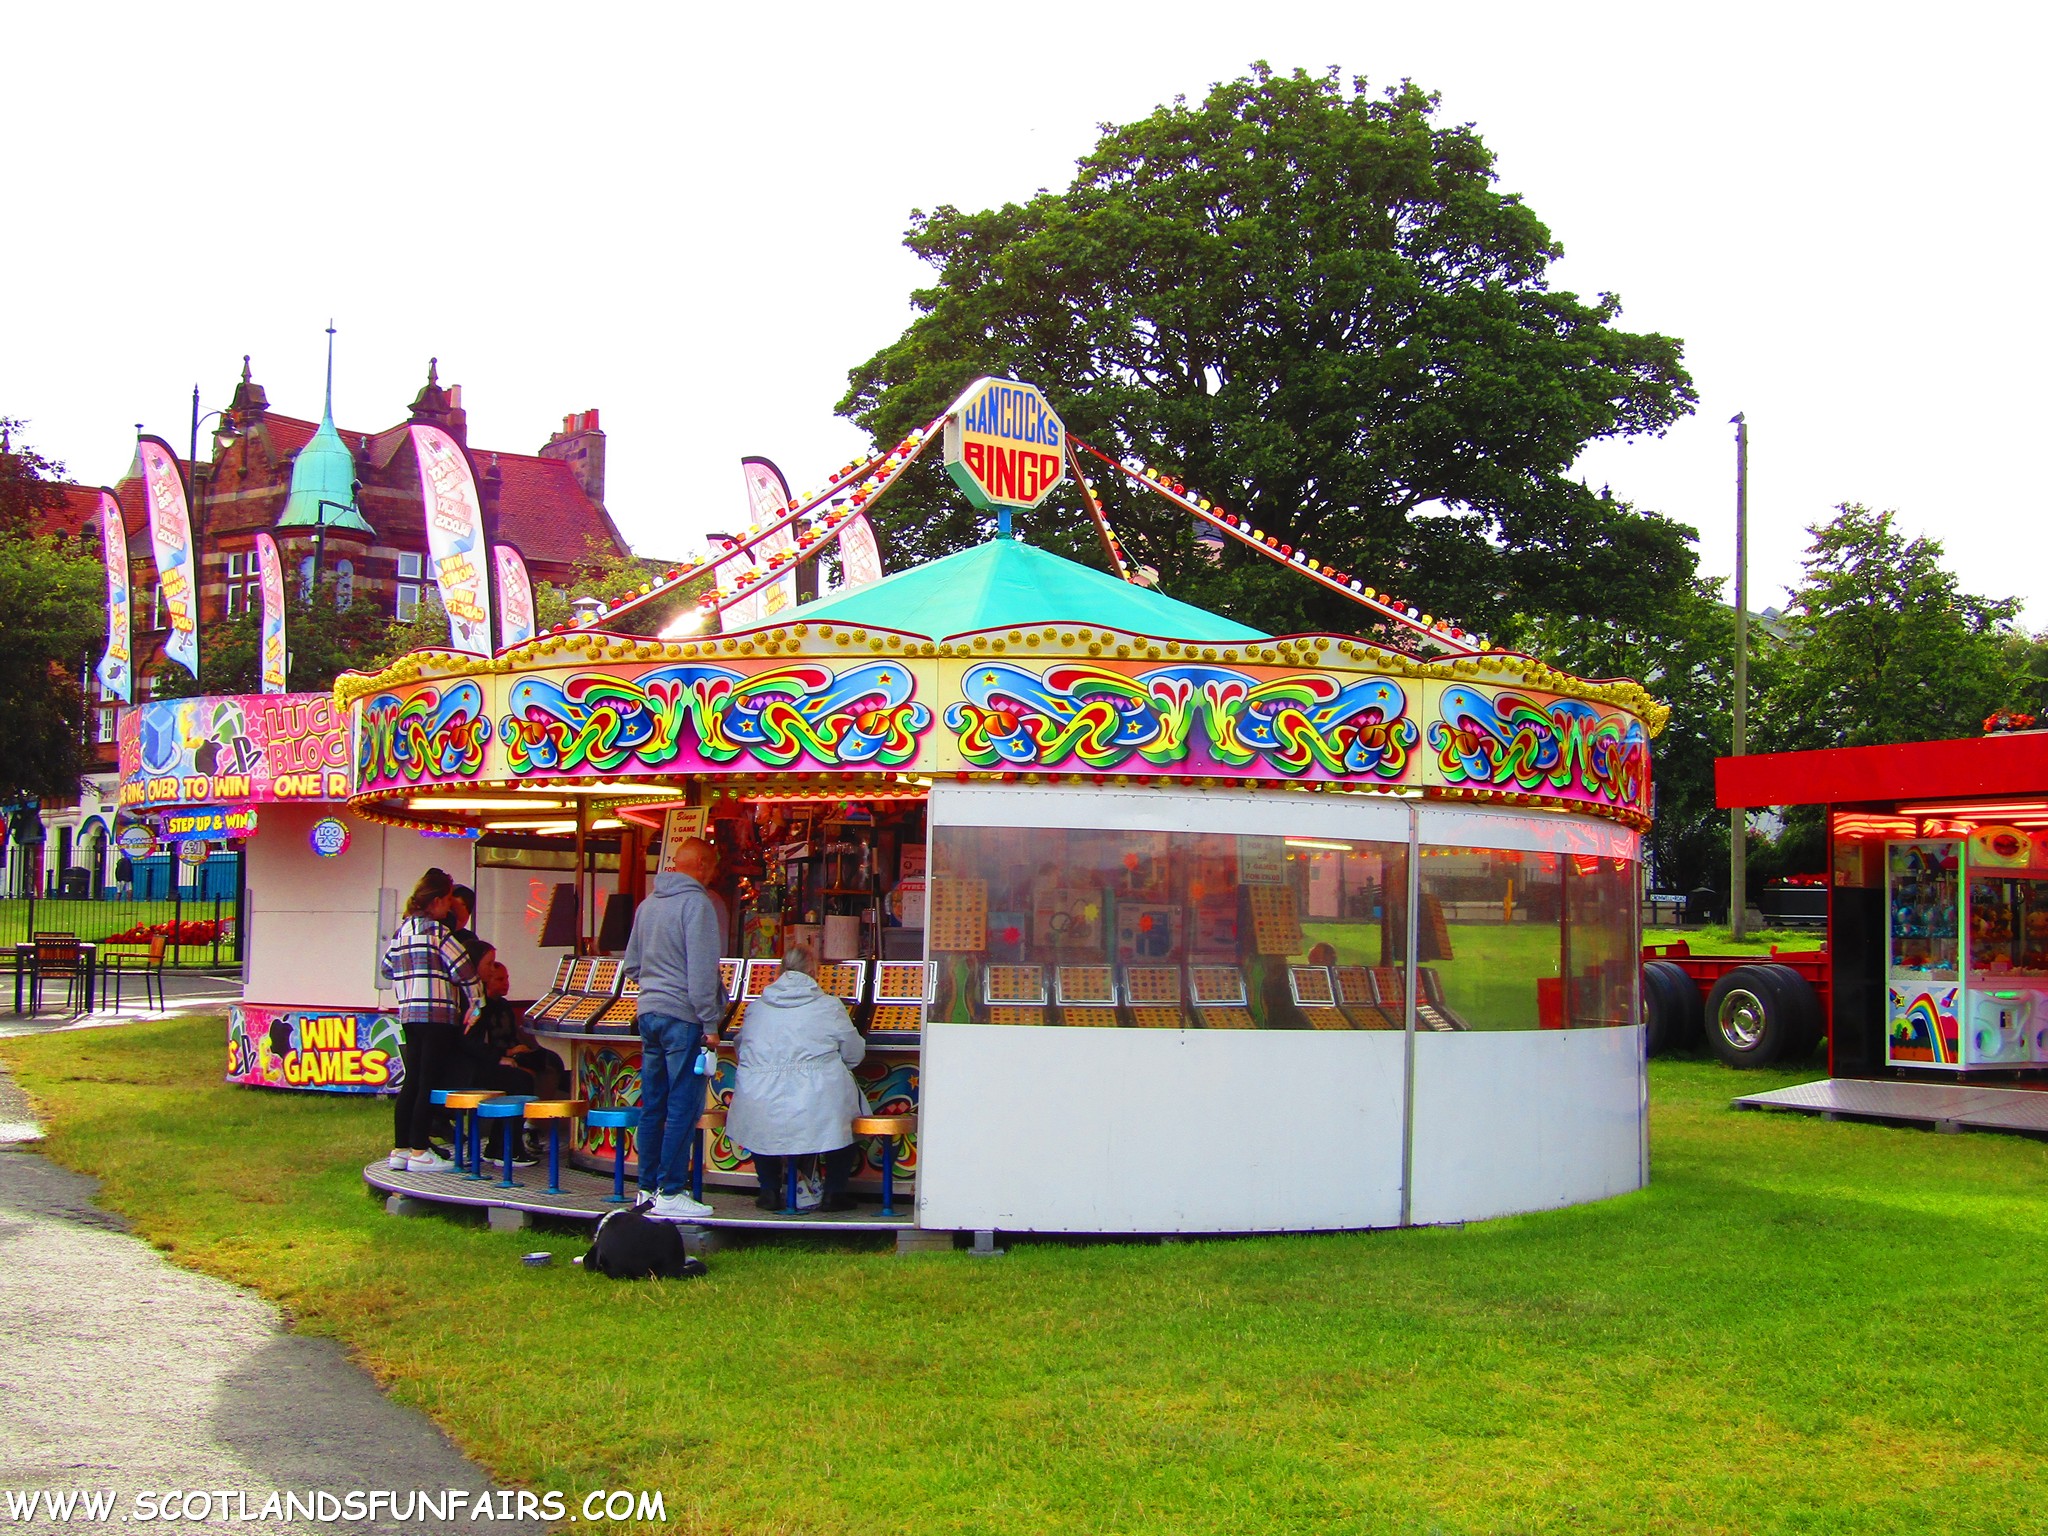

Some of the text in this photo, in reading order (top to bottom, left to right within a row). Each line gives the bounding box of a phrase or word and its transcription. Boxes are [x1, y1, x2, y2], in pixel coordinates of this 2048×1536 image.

[965, 386, 1059, 446] HANCOCKS
[964, 441, 1060, 502] BINGO
[127, 780, 146, 805] RING
[147, 775, 180, 803] OVER
[183, 774, 210, 801] TO
[213, 773, 251, 799] WIN
[273, 772, 324, 799] ONE
[168, 816, 195, 835] STEP
[195, 814, 212, 833] UP
[213, 814, 224, 831] &
[224, 812, 249, 830] WIN
[676, 811, 697, 823] Bingo
[678, 825, 696, 833] GAME
[316, 836, 345, 848] EASY
[319, 826, 341, 837] TOO
[299, 1014, 358, 1050] WIN
[283, 1048, 391, 1086] GAMES
